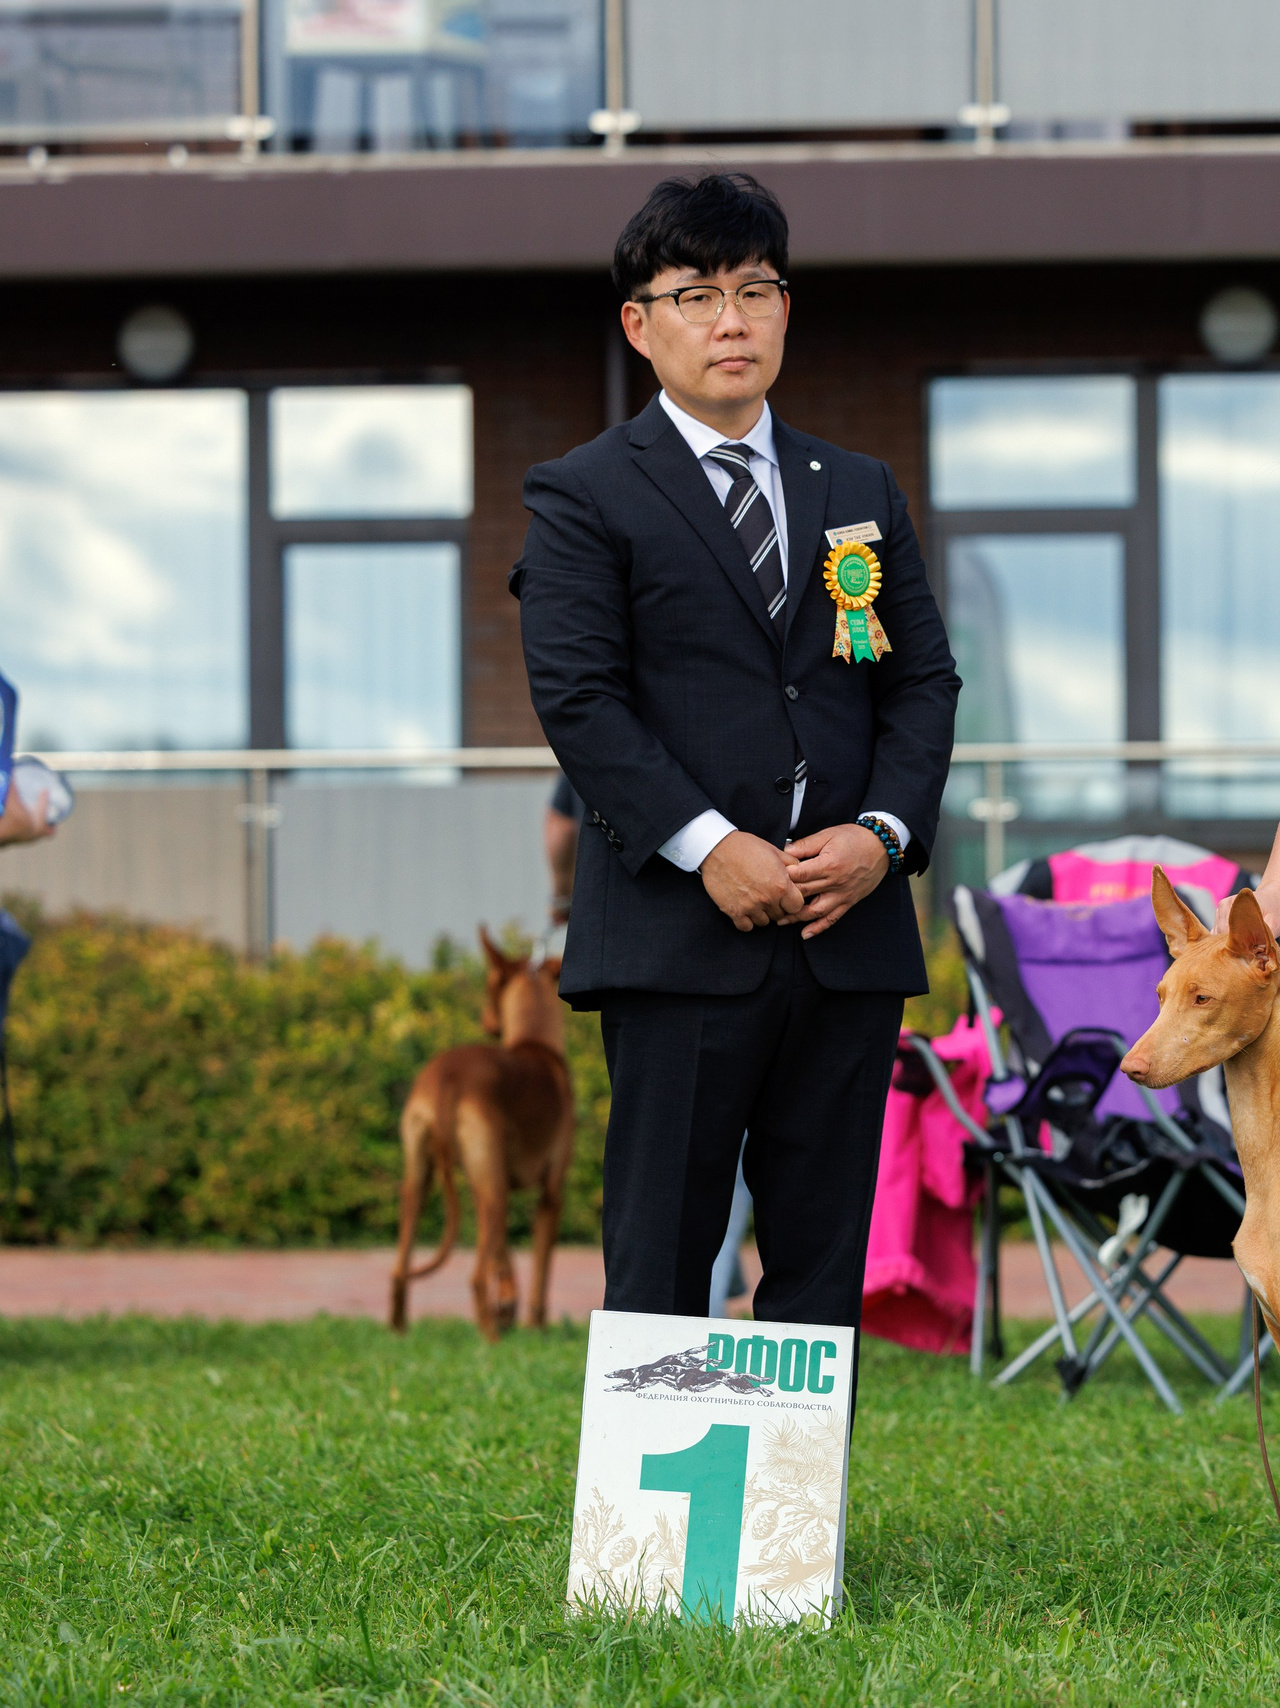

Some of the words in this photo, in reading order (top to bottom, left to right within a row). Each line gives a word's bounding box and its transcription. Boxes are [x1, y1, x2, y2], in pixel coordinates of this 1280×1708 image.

[706, 1332, 837, 1395] РФОС
[635, 1391, 689, 1403] ФЕДЕРАЦИЯ
[690, 1395, 755, 1407] ОХОТНИЧЬЕГО
[757, 1400, 833, 1412] СОБАКОВОДСТВА
[639, 1423, 750, 1632] 1
